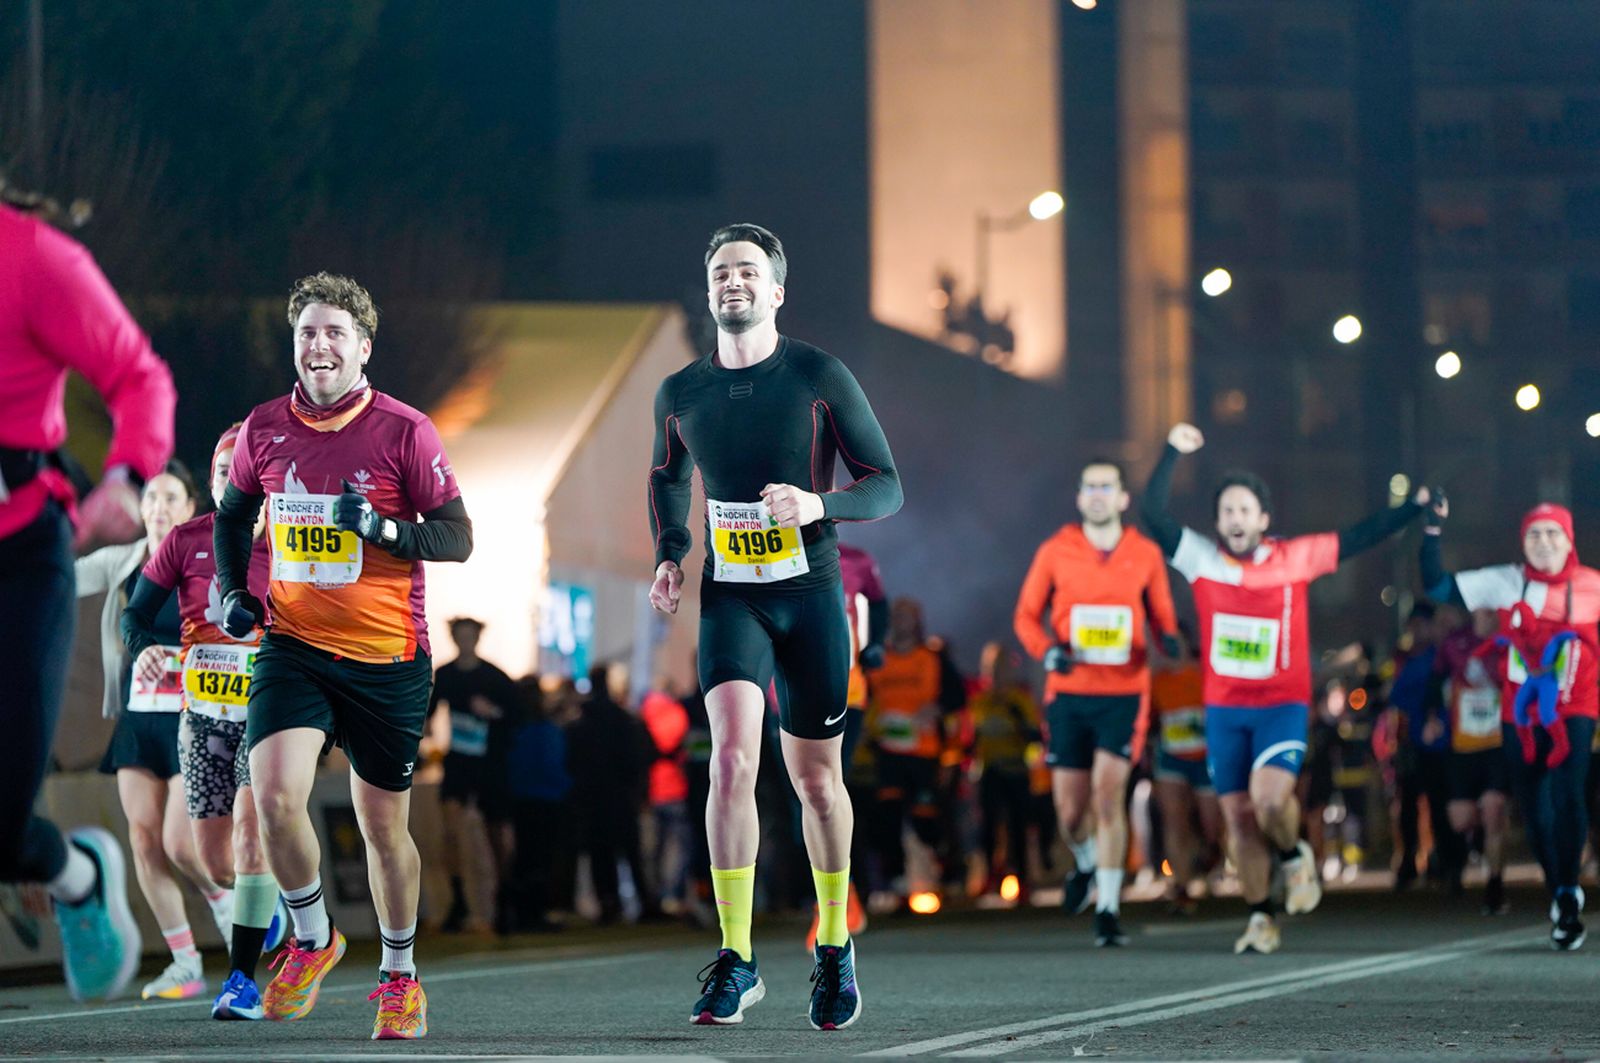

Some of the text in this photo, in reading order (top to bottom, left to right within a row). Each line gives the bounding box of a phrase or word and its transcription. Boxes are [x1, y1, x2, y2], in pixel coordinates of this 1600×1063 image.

[286, 504, 313, 514] NOCHE
[314, 505, 324, 514] DE
[279, 514, 293, 525] SAN
[723, 511, 760, 520] NOCHE DE
[717, 519, 732, 529] SAN
[286, 527, 342, 553] 4195
[728, 529, 783, 555] 4196
[204, 653, 240, 663] NOCHE DE
[197, 671, 252, 697] 13747
